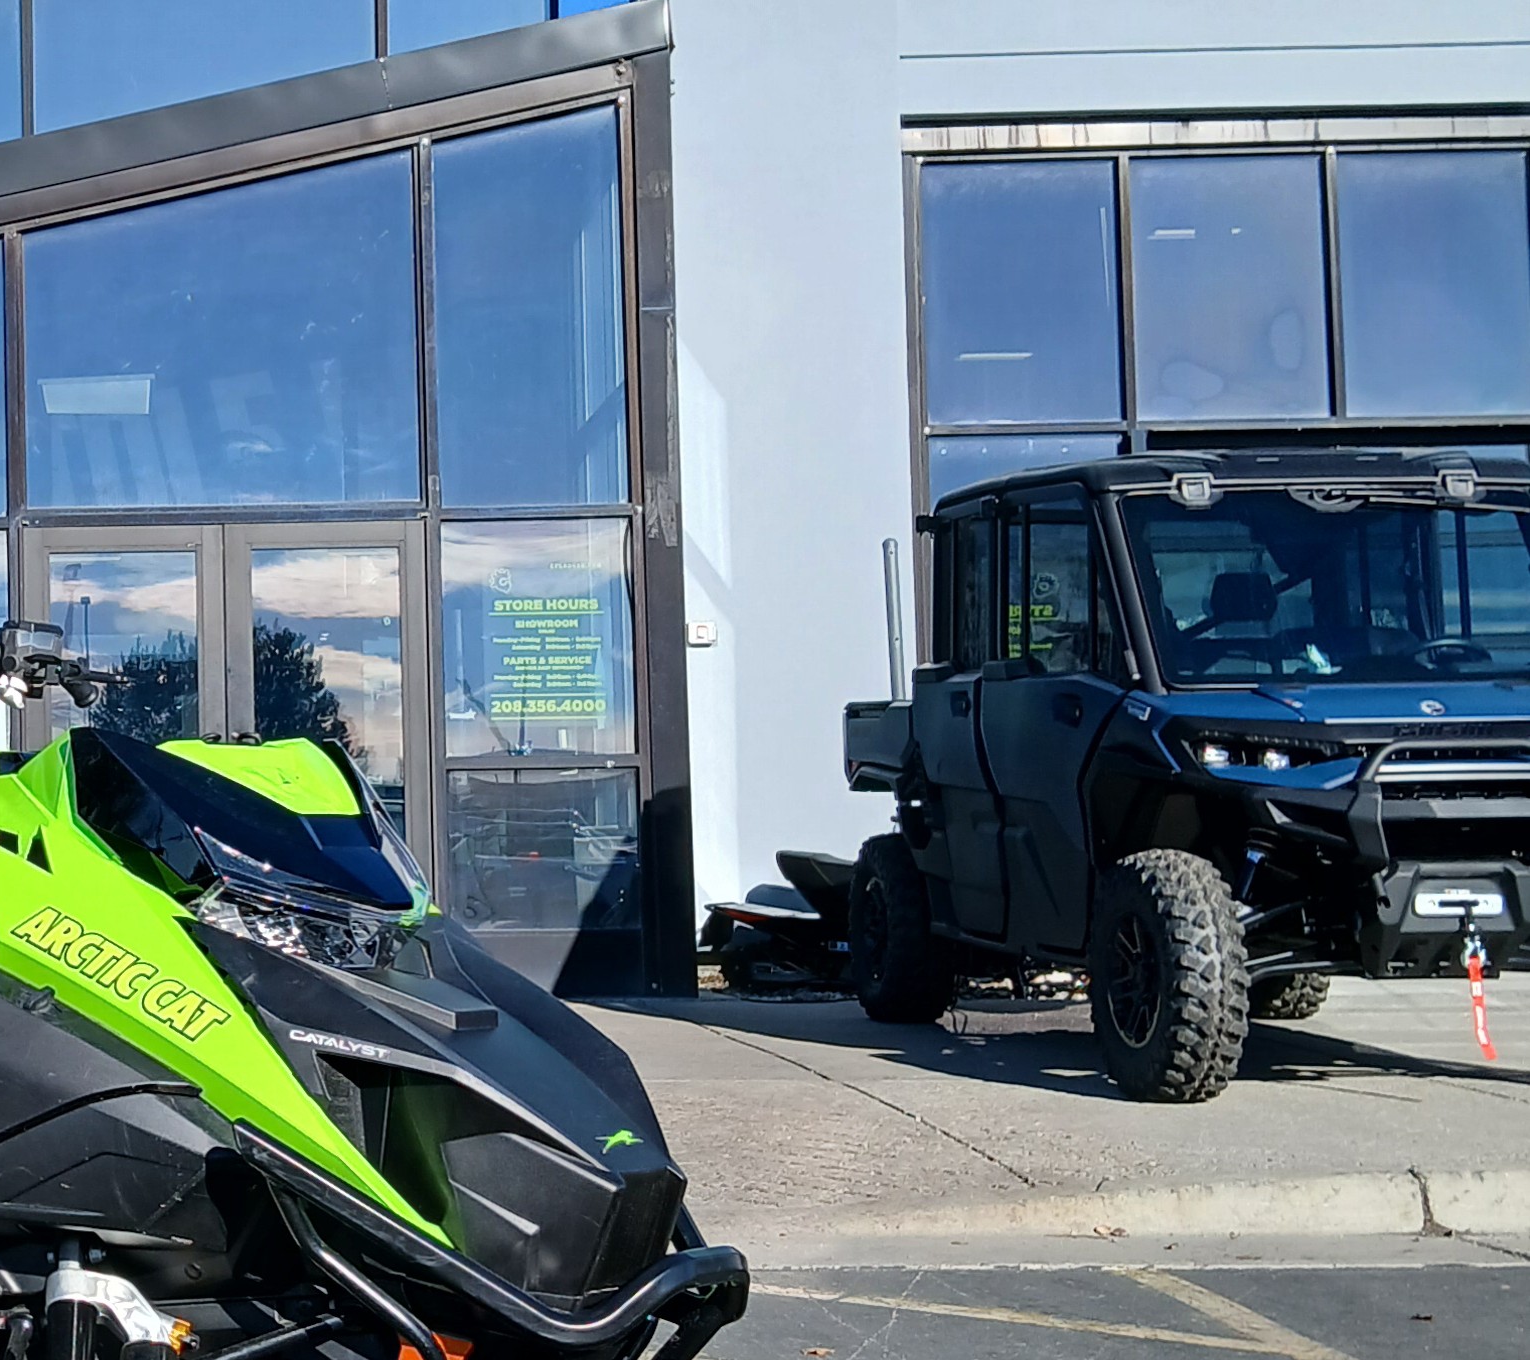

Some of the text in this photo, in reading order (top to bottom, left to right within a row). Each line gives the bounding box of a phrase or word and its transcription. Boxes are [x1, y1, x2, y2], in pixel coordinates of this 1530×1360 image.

[494, 598, 599, 611] STORE HOURS
[515, 619, 578, 628] SHOWROOM
[503, 656, 537, 665] PARTS
[548, 655, 592, 665] SERVICE
[491, 700, 606, 713] 208.356.4000
[10, 906, 232, 1043] ARCTIC CAT
[289, 1028, 389, 1059] CATALYST
